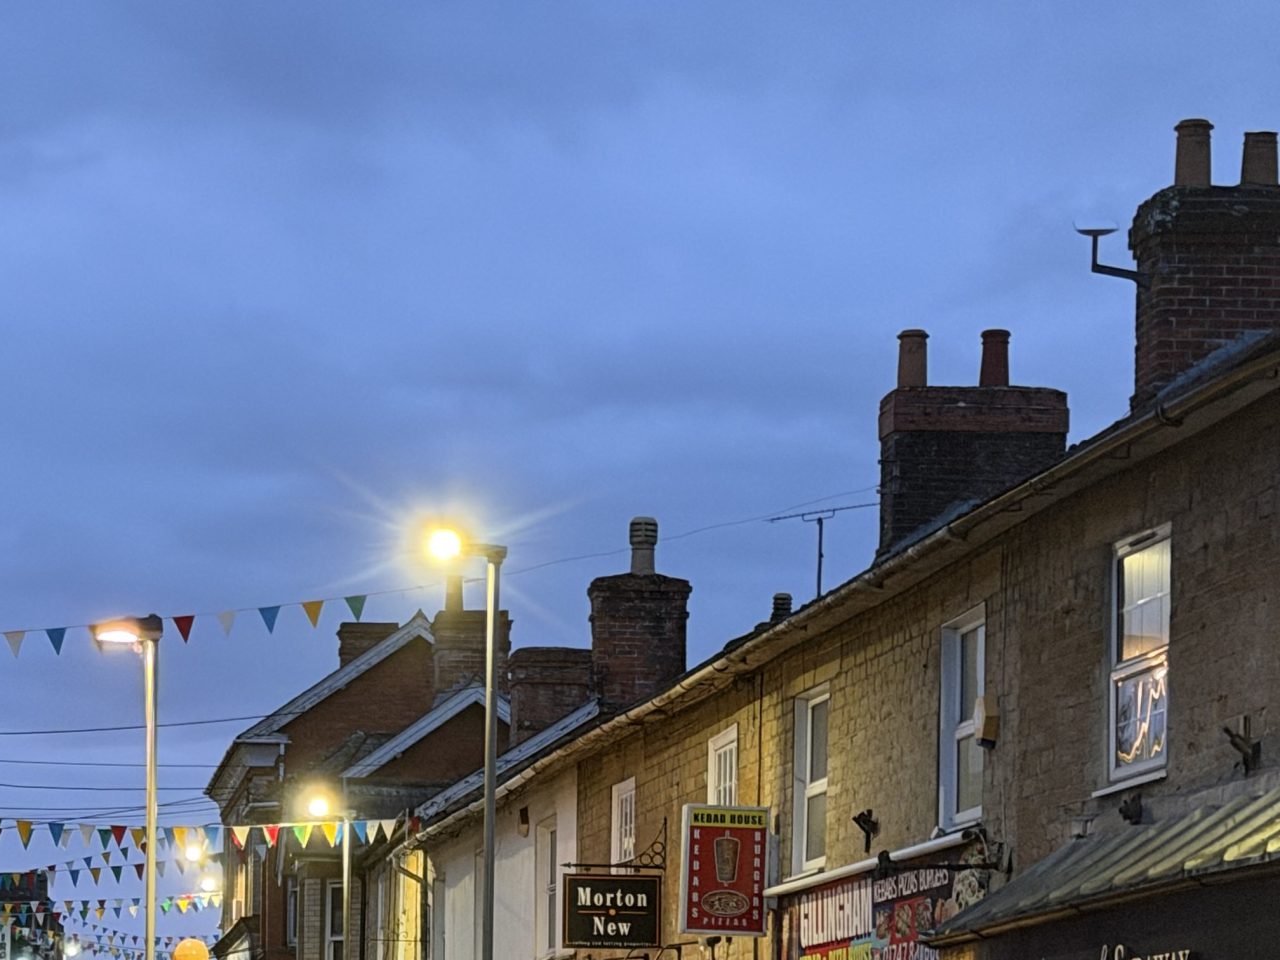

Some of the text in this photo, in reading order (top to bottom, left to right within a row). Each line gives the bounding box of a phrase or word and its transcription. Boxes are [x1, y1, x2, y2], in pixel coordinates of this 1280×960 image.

[693, 813, 764, 825] KEBAB HOUSE
[691, 829, 700, 918] KEBABS
[873, 876, 898, 903] KEBABS
[898, 870, 918, 898] PIZZAS
[577, 887, 648, 907] Morton
[593, 916, 631, 936] New
[800, 878, 872, 948] GILLINGHAM
